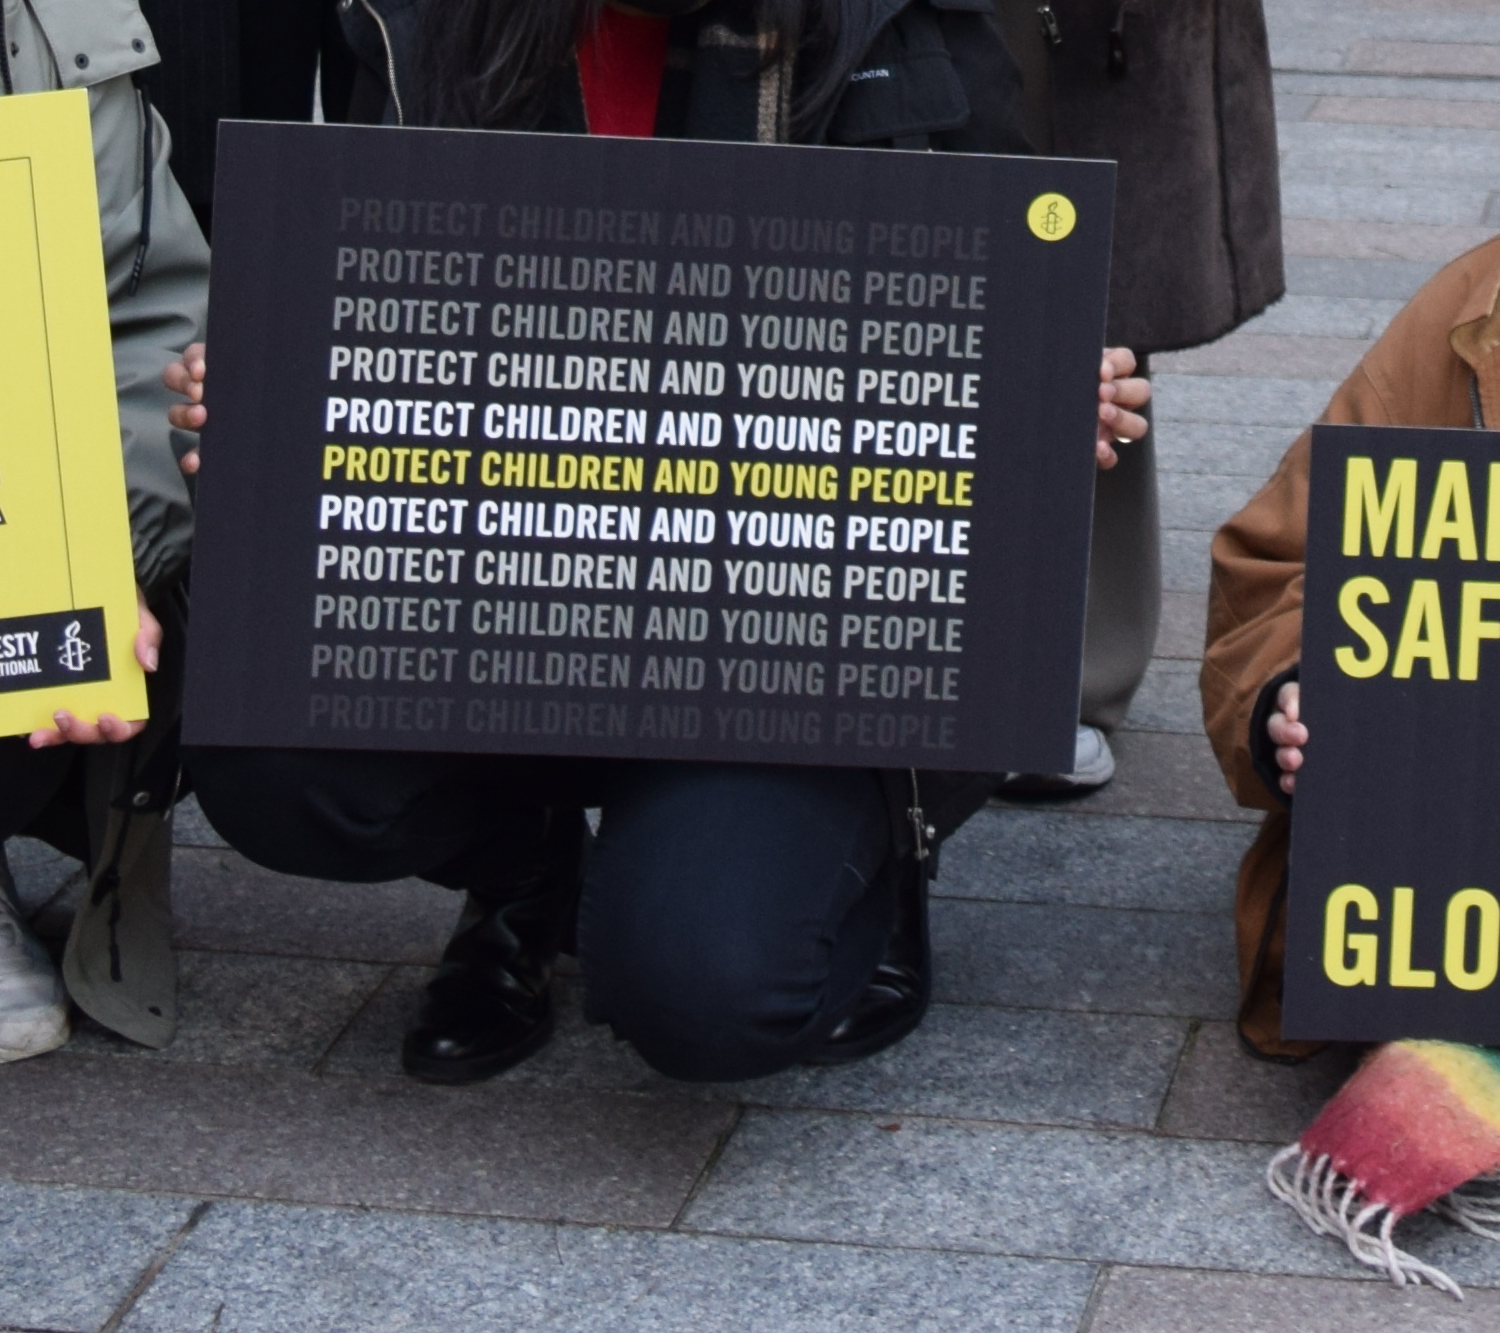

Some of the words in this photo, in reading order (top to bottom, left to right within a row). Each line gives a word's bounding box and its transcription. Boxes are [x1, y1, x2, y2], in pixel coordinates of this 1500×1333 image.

[851, 68, 889, 81] OUNTAIN
[340, 197, 487, 238] PROTECT
[498, 205, 659, 245] CHILDREN
[670, 213, 735, 249] AND
[748, 216, 854, 254] YOUNG
[867, 222, 990, 261] PEOPLE
[336, 247, 484, 287] PROTECT
[495, 254, 656, 294] CHILDREN
[667, 262, 732, 298] AND
[745, 265, 851, 303] YOUNG
[864, 271, 986, 309] PEOPLE
[333, 297, 480, 336] PROTECT
[492, 303, 653, 343] CHILDREN
[663, 311, 729, 347] AND
[741, 315, 848, 352] YOUNG
[861, 320, 983, 358] PEOPLE
[330, 346, 477, 386] PROTECT
[488, 353, 650, 393] CHILDREN
[660, 361, 725, 396] AND
[738, 364, 844, 401] YOUNG
[857, 369, 980, 407] PEOPLE
[327, 396, 474, 435] PROTECT
[485, 402, 647, 442] CHILDREN
[657, 410, 722, 445] AND
[735, 413, 841, 450] YOUNG
[854, 418, 977, 456] PEOPLE
[324, 445, 471, 484] PROTECT
[482, 451, 643, 491] CHILDREN
[654, 459, 719, 494] AND
[731, 462, 838, 499] YOUNG
[851, 467, 973, 505] PEOPLE
[321, 495, 468, 534] PROTECT
[479, 501, 640, 540] CHILDREN
[651, 509, 715, 543] AND
[728, 511, 835, 548] YOUNG
[847, 516, 970, 554] PEOPLE
[317, 545, 464, 583] PROTECT
[475, 550, 637, 589] CHILDREN
[648, 558, 712, 592] AND
[725, 560, 831, 597] YOUNG
[844, 565, 967, 603] PEOPLE
[314, 594, 461, 632] PROTECT
[472, 600, 634, 639] CHILDREN
[644, 608, 709, 642] AND
[721, 609, 828, 647] YOUNG
[841, 614, 963, 652] PEOPLE
[311, 644, 458, 682] PROTECT
[469, 649, 631, 688] CHILDREN
[641, 657, 705, 691] AND
[718, 659, 825, 696] YOUNG
[838, 663, 960, 701] PEOPLE
